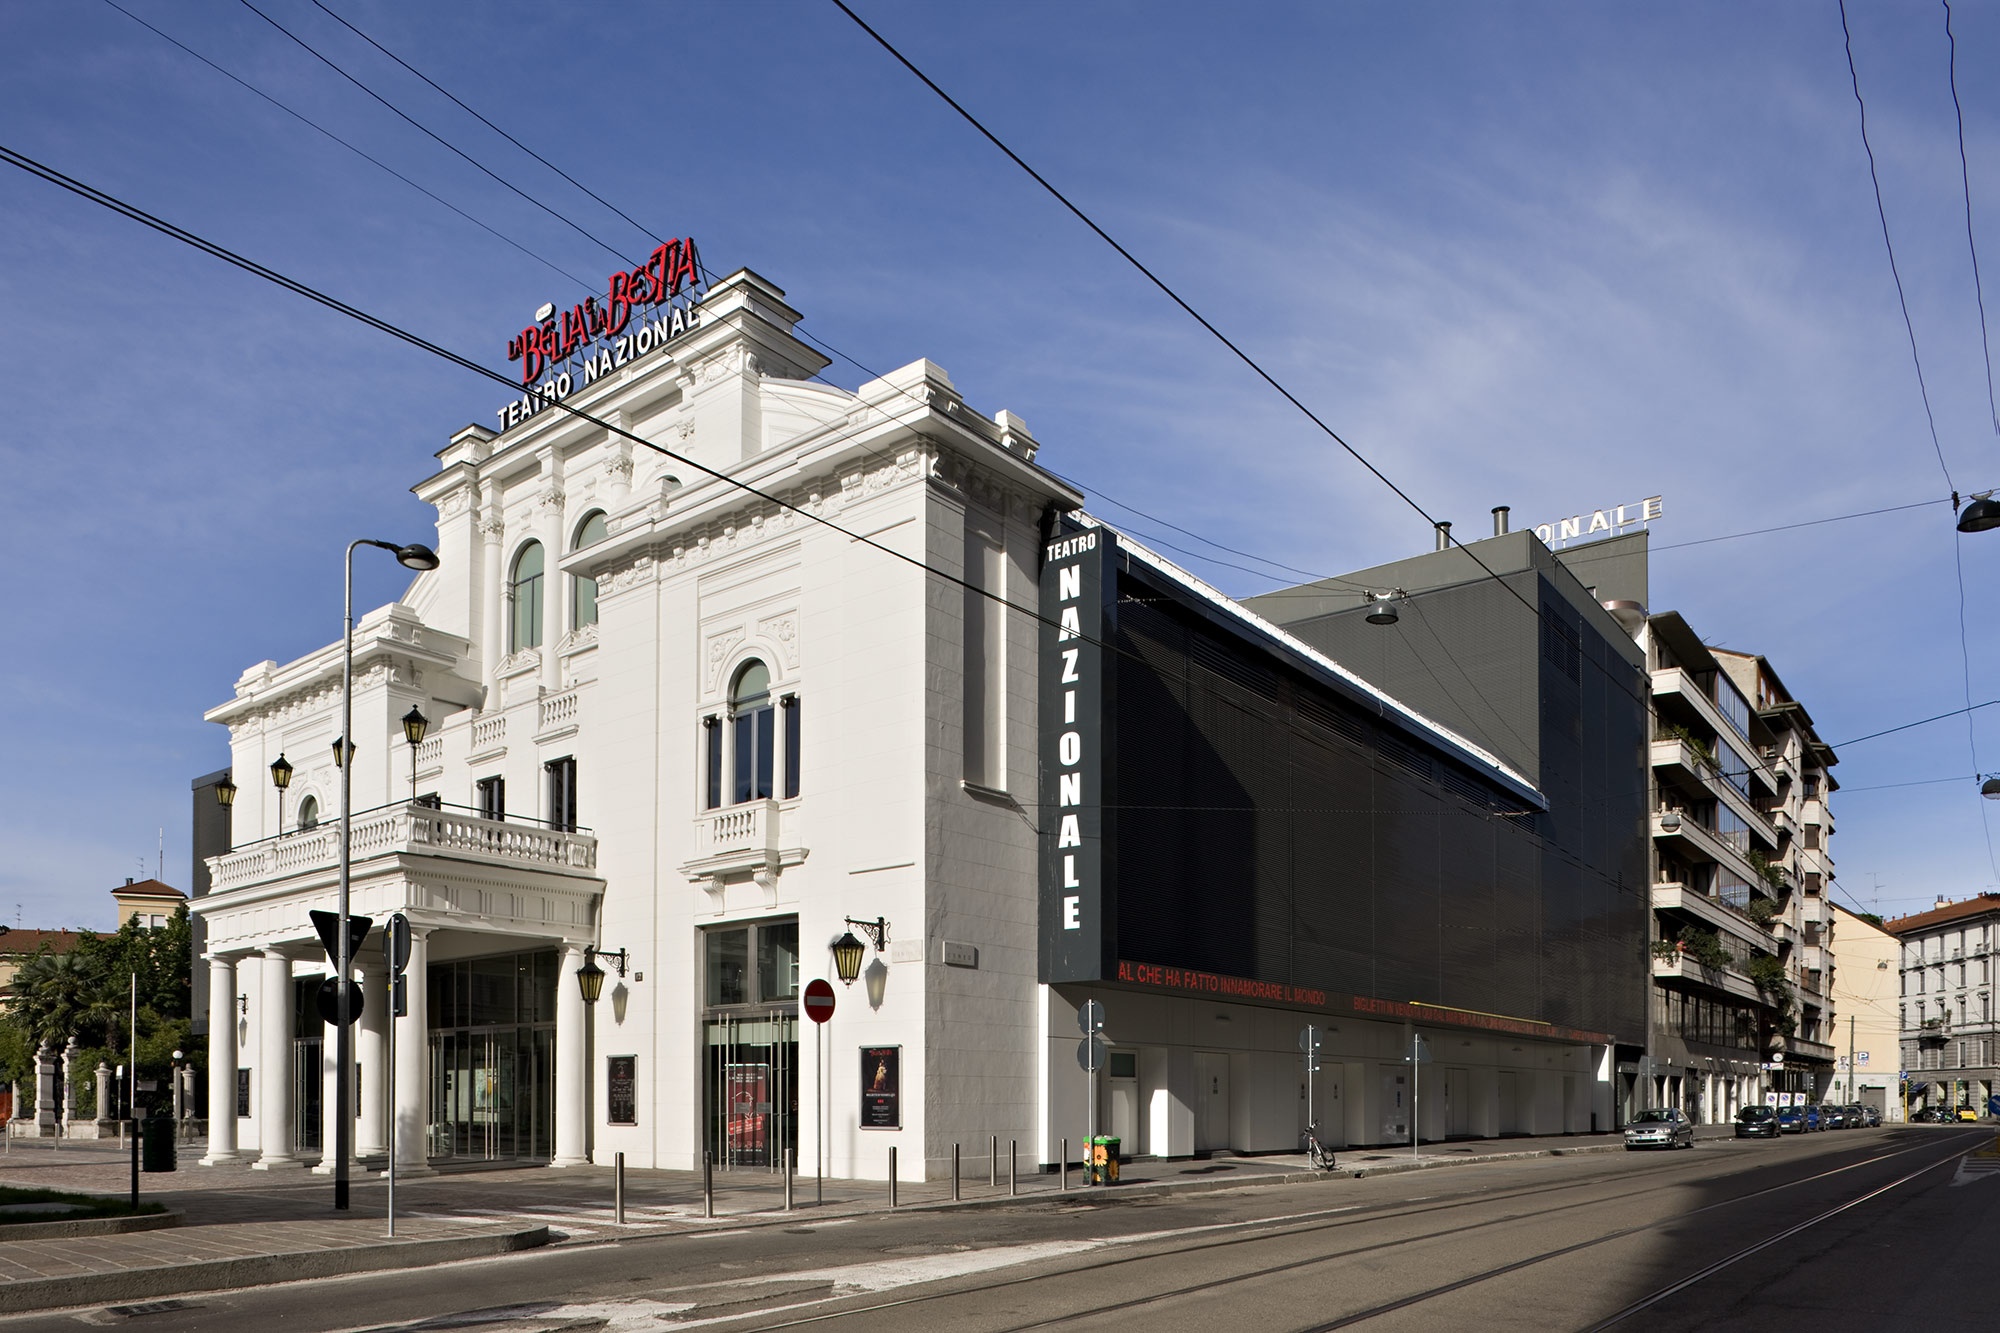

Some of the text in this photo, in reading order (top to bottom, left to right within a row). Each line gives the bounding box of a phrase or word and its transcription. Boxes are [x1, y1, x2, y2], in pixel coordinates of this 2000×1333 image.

[508, 334, 523, 361] LA
[521, 304, 590, 386] BELLA
[605, 237, 701, 340] BESTIA
[497, 372, 573, 433] TEATRO
[1047, 532, 1096, 562] TEATRO
[1058, 564, 1082, 930] NAZIONALE
[1137, 964, 1162, 985] CHE
[1165, 968, 1181, 987] HA
[1184, 971, 1218, 992] FATTO
[1220, 977, 1283, 1000] INNAMORARE
[1285, 986, 1293, 1002] IL
[1294, 988, 1326, 1006] MONDO
